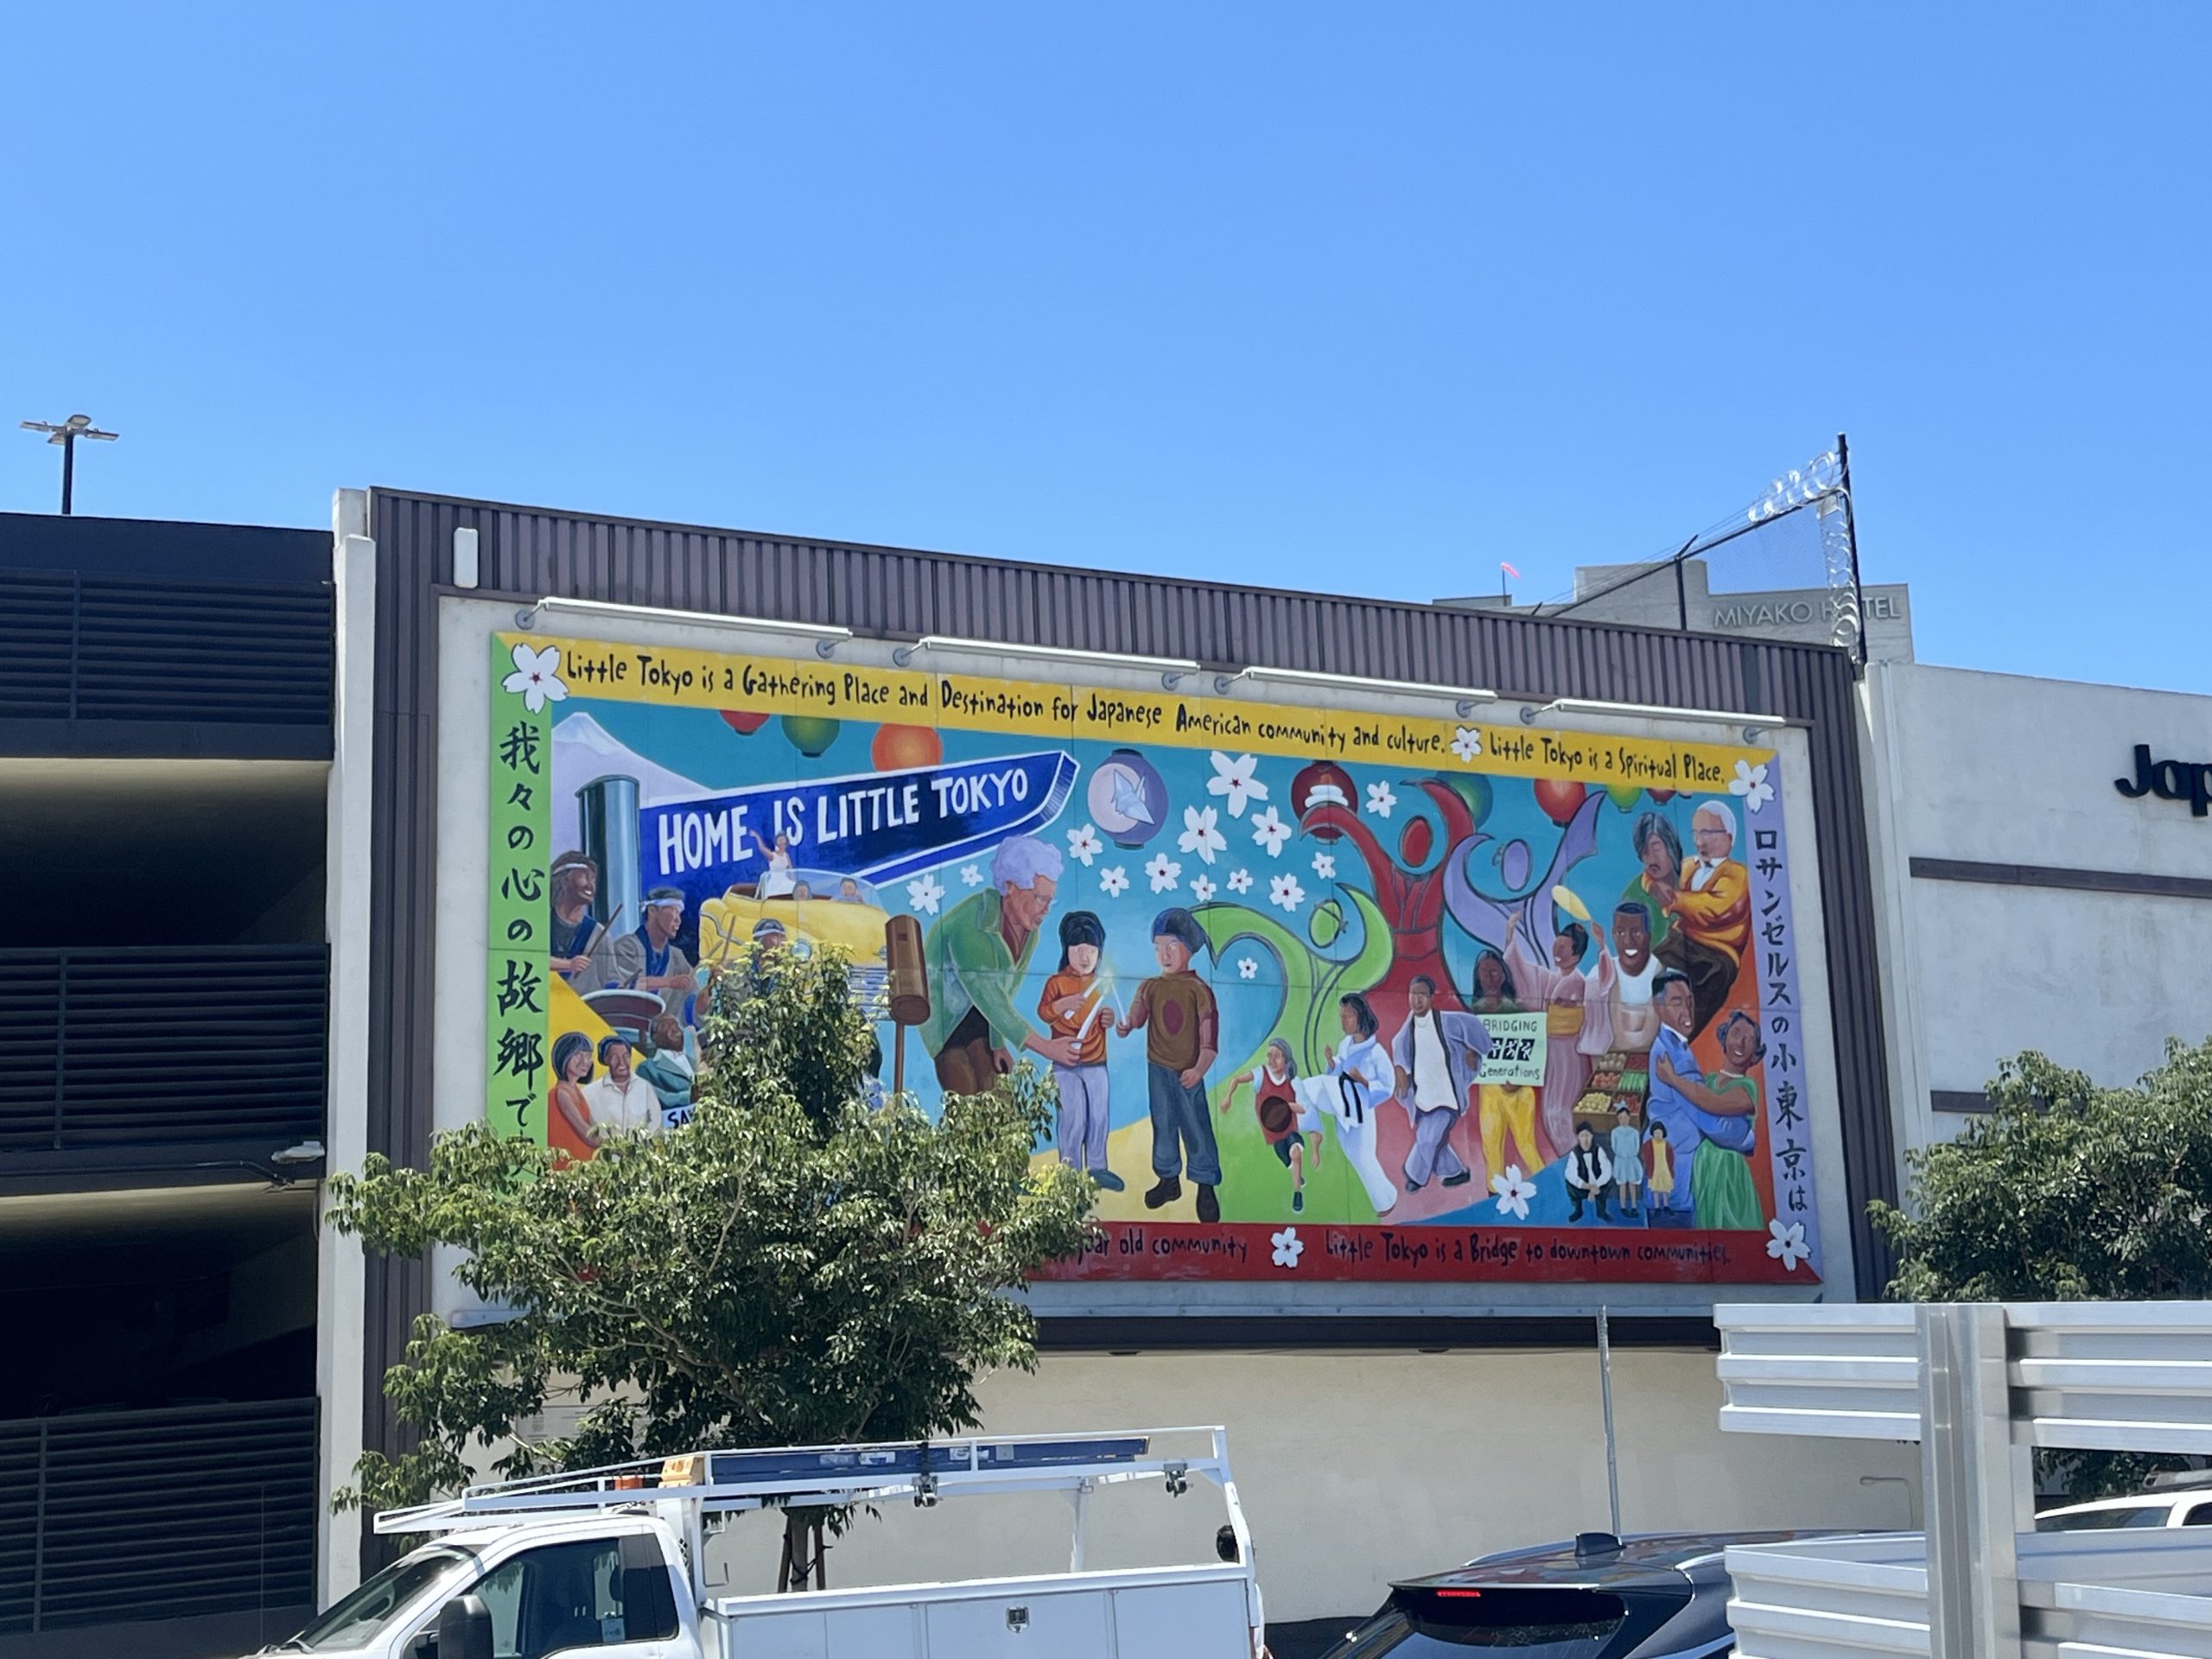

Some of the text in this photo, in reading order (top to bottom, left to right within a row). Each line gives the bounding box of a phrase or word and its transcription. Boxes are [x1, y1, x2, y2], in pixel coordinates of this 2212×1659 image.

[1713, 596, 1901, 628] MIYAKO HTEL
[567, 651, 1446, 754] Little Tokyo is a Gathering Place and Destination for Japanese American community and culture.
[1490, 732, 1534, 762] Little
[1541, 736, 1583, 772] Tokyo
[1588, 747, 1598, 772] is
[1605, 751, 1613, 769] a
[1618, 747, 1676, 779] Spiritual
[658, 767, 1028, 875] HOME IS LITTLE TOKYO
[1483, 1019, 1538, 1033] BRIDGING
[1753, 828, 1808, 1212] ロサンゼルスの小東京は
[1478, 1064, 1540, 1080] Generations
[667, 1107, 696, 1129] SA
[1119, 1227, 1144, 1256] old
[1152, 1232, 1248, 1263] community
[1325, 1230, 1374, 1265] Little
[1380, 1232, 1428, 1268] Tokyo
[1435, 1238, 1446, 1263] is
[1452, 1240, 1463, 1261] a
[1470, 1231, 1518, 1268] Bridge
[1525, 1243, 1542, 1263] to
[1550, 1238, 1631, 1266] downtown
